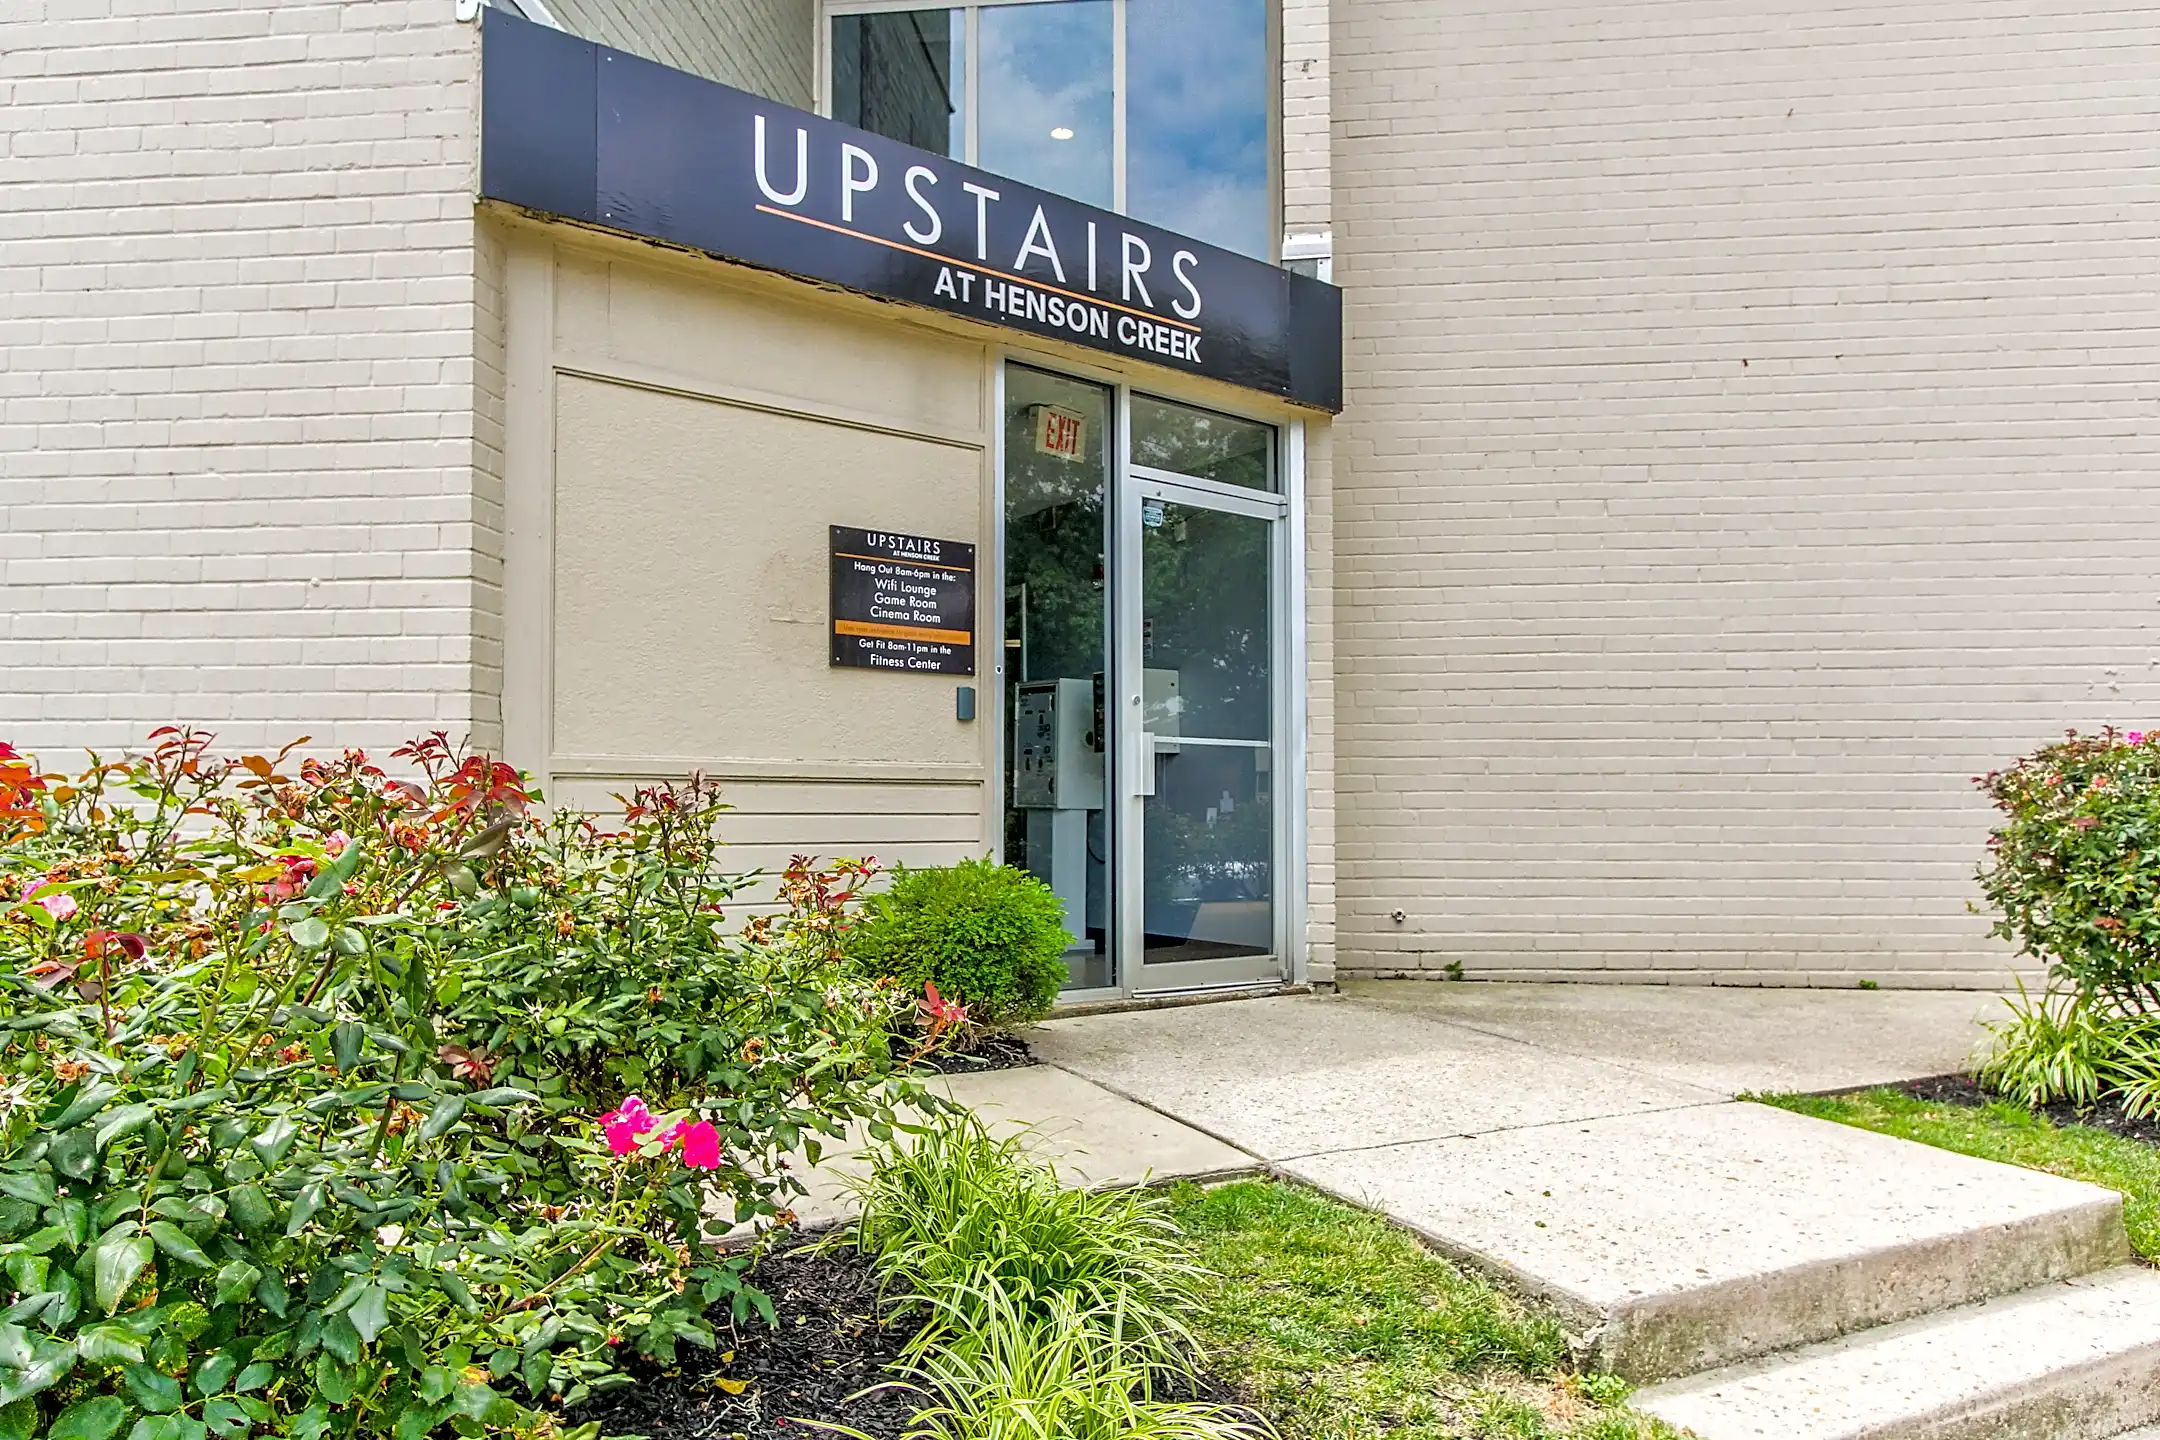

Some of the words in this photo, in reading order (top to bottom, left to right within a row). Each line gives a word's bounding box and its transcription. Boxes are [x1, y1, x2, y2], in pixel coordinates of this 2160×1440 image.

[754, 115, 1202, 320] UPSTAIRS
[934, 266, 976, 302] AT
[985, 279, 1110, 339] HENSON
[1117, 316, 1202, 363] CREEK
[1046, 412, 1080, 455] EXIT
[867, 533, 941, 554] UPSTAIRS
[854, 561, 876, 575] Hang
[878, 564, 893, 574] Out
[895, 566, 931, 580] 8am-6pm
[933, 571, 940, 580] in
[941, 571, 957, 582] the:
[874, 578, 898, 592] Wifi
[901, 581, 937, 598] Lounge
[874, 592, 906, 606] Game
[909, 596, 937, 609] Room
[870, 606, 910, 621] Cinema
[913, 610, 941, 623] Room
[859, 639, 874, 649] Get
[876, 640, 886, 650] Fit
[888, 641, 928, 655] 8am-11pm
[930, 644, 939, 654] in
[940, 645, 952, 655] the
[870, 653, 905, 668] Fitness
[907, 656, 941, 671] Center
